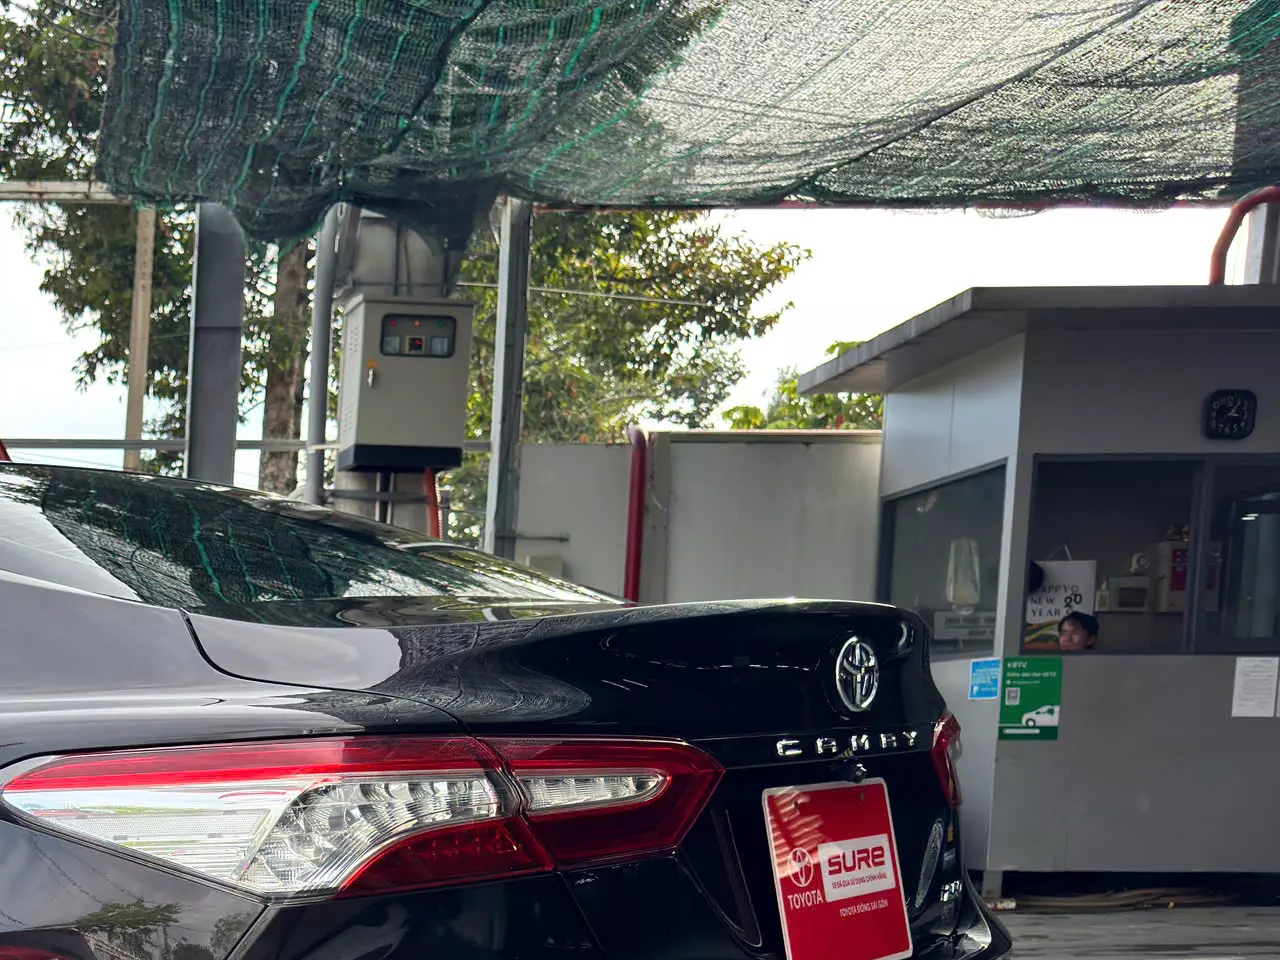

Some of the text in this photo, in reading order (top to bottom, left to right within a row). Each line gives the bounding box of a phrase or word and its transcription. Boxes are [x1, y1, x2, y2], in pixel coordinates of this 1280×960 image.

[776, 731, 918, 756] CAMRY
[788, 889, 824, 910] TOYOTA
[840, 905, 857, 917] TOYOTA
